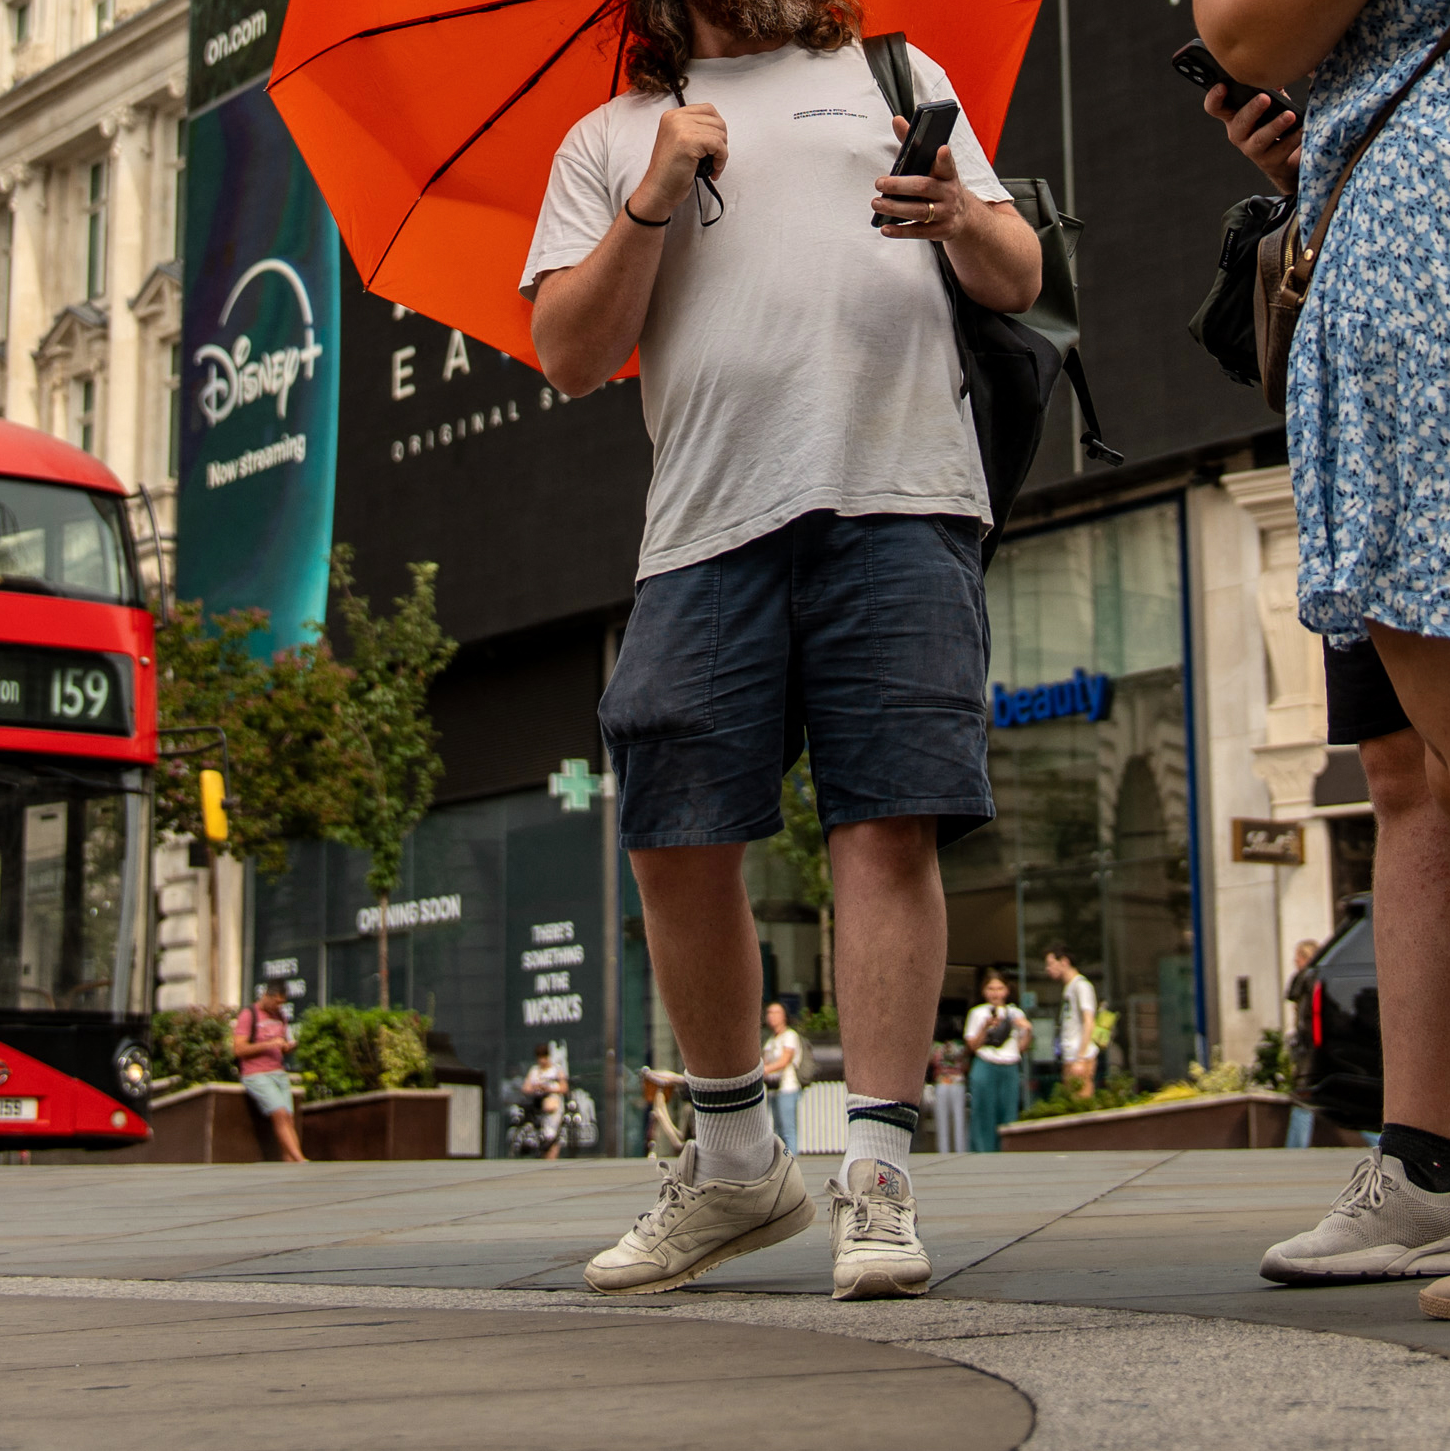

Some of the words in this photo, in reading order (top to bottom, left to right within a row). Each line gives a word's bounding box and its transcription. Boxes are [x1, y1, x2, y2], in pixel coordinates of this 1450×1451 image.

[203, 8, 268, 67] on.com
[193, 326, 324, 427] Disney+
[390, 400, 521, 463] ORIGINAL
[206, 460, 238, 490] Now
[239, 433, 307, 479] streaming
[51, 667, 109, 719] 159
[992, 667, 1108, 728] beauty
[420, 893, 462, 925] SOON
[522, 993, 583, 1027] WORKS
